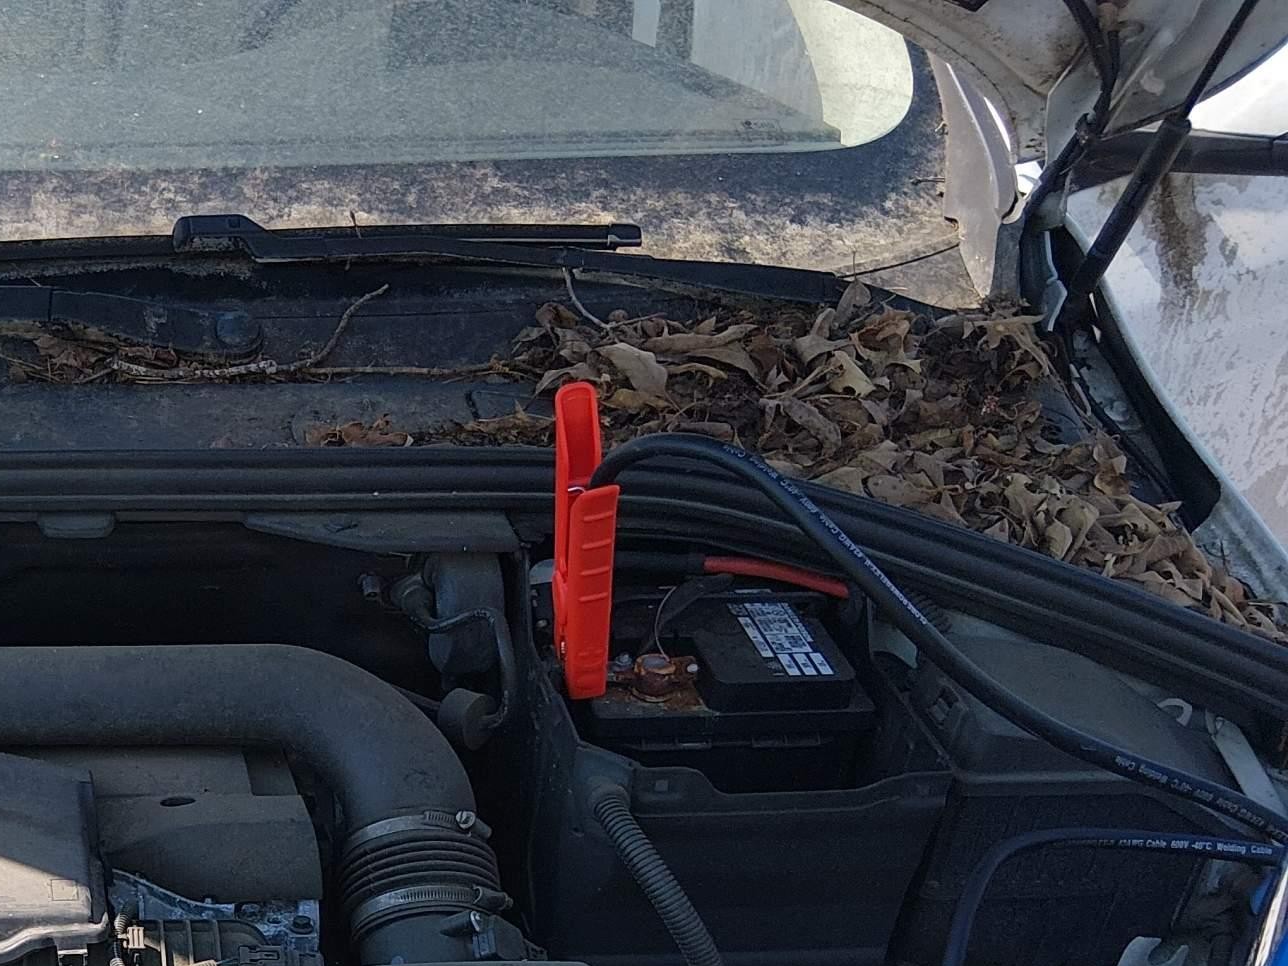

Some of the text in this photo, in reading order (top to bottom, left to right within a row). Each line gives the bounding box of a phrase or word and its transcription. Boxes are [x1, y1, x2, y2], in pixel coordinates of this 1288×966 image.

[750, 456, 778, 480] Welding
[819, 514, 839, 534] Cable
[1114, 755, 1136, 771] Cable
[1145, 839, 1167, 849] Cable
[1216, 843, 1246, 855] Welding
[1250, 845, 1273, 855] Cable
